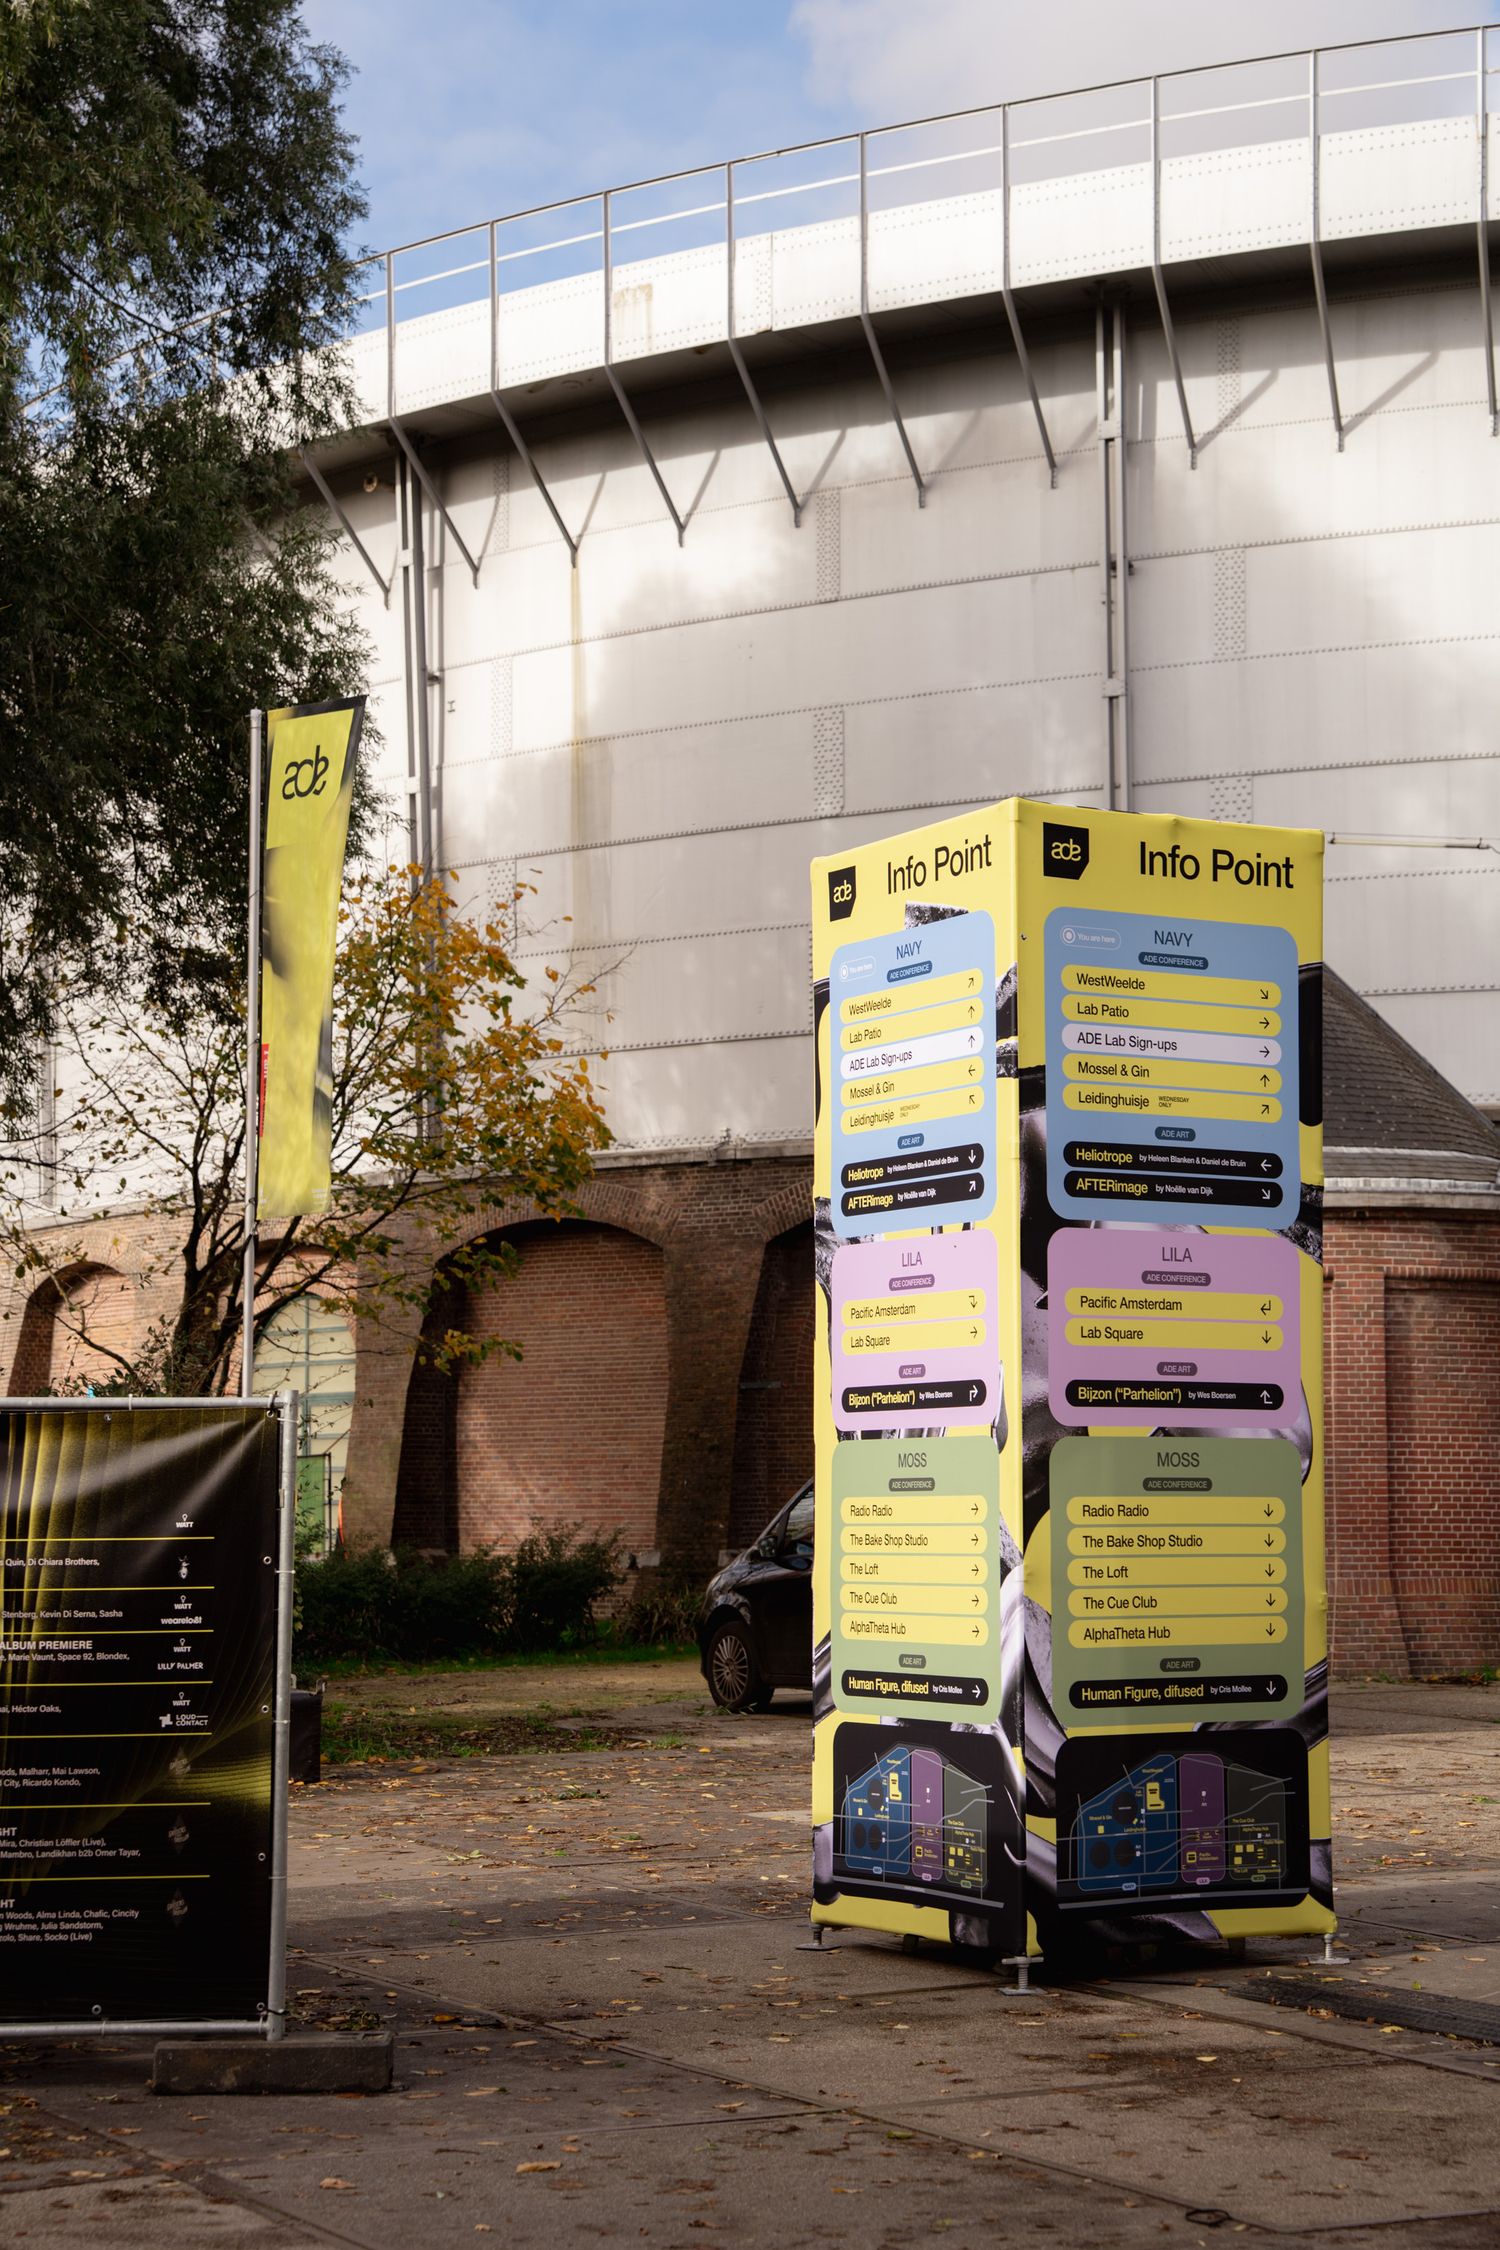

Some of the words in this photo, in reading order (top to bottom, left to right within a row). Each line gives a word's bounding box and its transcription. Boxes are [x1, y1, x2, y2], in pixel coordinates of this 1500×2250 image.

[282, 745, 329, 800] ade
[1051, 838, 1081, 862] ade
[888, 856, 927, 895] Info
[935, 834, 992, 881] Point
[1140, 841, 1200, 880] Info
[1212, 848, 1294, 889] Point
[833, 880, 852, 903] ade
[1077, 932, 1088, 942] You
[1100, 935, 1116, 944] here
[1154, 930, 1193, 947] NAVY
[896, 940, 922, 960] NAVY
[1144, 955, 1158, 964] ADE
[1158, 956, 1204, 968] CONFERENCE
[1076, 973, 1145, 990] WestWeelde
[849, 998, 892, 1016] WestWeelde
[1077, 1002, 1098, 1016] Lab
[1101, 1004, 1129, 1018] Patio
[850, 1032, 862, 1044] Lab
[864, 1028, 882, 1041] Patio
[1077, 1032, 1102, 1045] ADE
[1105, 1034, 1126, 1047] Lab
[1128, 1036, 1178, 1052] Sign-ups
[850, 1060, 865, 1071] ADE
[866, 1056, 879, 1068] Lab
[881, 1050, 912, 1066] Sign-ups
[1078, 1062, 1117, 1076] Mossel
[1121, 1064, 1129, 1077] &
[1131, 1065, 1150, 1078] Gin
[850, 1085, 874, 1100] Mossel
[876, 1083, 882, 1094] &
[883, 1081, 894, 1093] Gin
[1078, 1091, 1150, 1110] Leidinghuisje
[850, 1110, 894, 1128] Leidinghuisje
[1161, 1130, 1176, 1138] ADE
[1176, 1130, 1190, 1139] ART
[1076, 1148, 1133, 1166] Heliotrope
[1139, 1153, 1147, 1162] by
[1148, 1154, 1169, 1163] Heleen
[1170, 1155, 1195, 1164] Blanken
[1195, 1157, 1200, 1165] &
[1201, 1156, 1221, 1166] Daniel
[1221, 1158, 1229, 1166] de
[1230, 1158, 1246, 1167] Bruin
[848, 1167, 884, 1182] Heliotrope
[1076, 1178, 1148, 1196] AFTERimage
[1156, 1184, 1164, 1193] by
[1165, 1184, 1186, 1194] Noëlle
[1200, 1186, 1214, 1196] Dijk
[848, 1194, 894, 1210] AFTERimage
[902, 1251, 922, 1267] LILA
[1162, 1247, 1192, 1262] LILA
[1146, 1274, 1161, 1282] ADE
[1162, 1274, 1206, 1284] CONFERENCE
[850, 1306, 874, 1319] Pacific
[875, 1303, 916, 1317] Amsterdam
[1080, 1296, 1117, 1309] Pacific
[1120, 1297, 1182, 1310] Amsterdam
[850, 1336, 864, 1348] Lab
[865, 1334, 890, 1349] Square
[1080, 1326, 1102, 1339] Lab
[1104, 1327, 1144, 1342] Square
[1178, 1365, 1191, 1373] ART
[849, 1392, 870, 1408] Bijzon
[1078, 1386, 1112, 1403] Bijzon
[1188, 1392, 1196, 1400] by
[1211, 1392, 1236, 1400] Boersen
[898, 1452, 927, 1468] MOSS
[1157, 1452, 1200, 1468] MOSS
[1162, 1481, 1208, 1489] CONFERENCE
[850, 1504, 870, 1516] Radio
[872, 1504, 892, 1516] Radio
[1082, 1504, 1114, 1517] Radio
[1118, 1504, 1149, 1517] Radio
[850, 1534, 863, 1546] The
[865, 1534, 882, 1546] Bake
[884, 1534, 902, 1548] Shop
[904, 1534, 928, 1546] Studio
[1082, 1536, 1104, 1548] The
[1106, 1535, 1134, 1548] Bake
[1137, 1535, 1166, 1550] Shop
[1168, 1534, 1202, 1547] Studio
[5, 1558, 26, 1567] Quin,
[28, 1558, 36, 1566] Di
[38, 1558, 63, 1566] Chiara
[64, 1558, 100, 1566] Brothers,
[850, 1562, 863, 1574] The
[865, 1562, 878, 1575] Loft
[1083, 1566, 1104, 1579] The
[1107, 1566, 1128, 1578] Loft
[850, 1592, 862, 1604] The
[864, 1592, 879, 1604] Cue
[881, 1592, 898, 1604] Club
[1083, 1597, 1104, 1609] The
[1107, 1596, 1130, 1609] Cue
[1132, 1596, 1157, 1608] Club
[2, 1610, 38, 1620] Stenberg,
[40, 1610, 61, 1618] Kevin
[63, 1610, 72, 1618] Di
[73, 1610, 98, 1618] Serna,
[99, 1610, 123, 1618] Sasha
[850, 1620, 890, 1635] AlphaTheta
[891, 1622, 906, 1634] Hub
[1084, 1627, 1145, 1643] AlphaTheta
[1148, 1626, 1170, 1638] Hub
[0, 1640, 36, 1650] ALBUM
[39, 1640, 93, 1650] PREMIERE
[32, 1653, 56, 1661] Vaunt,
[58, 1652, 81, 1662] Space
[83, 1652, 95, 1661] 92,
[96, 1652, 130, 1660] Blondex,
[158, 1662, 176, 1670] LILLY
[176, 1662, 204, 1670] PALMER
[848, 1677, 874, 1690] Human
[876, 1679, 900, 1694] Figure,
[902, 1680, 928, 1694] difused
[1082, 1688, 1122, 1701] Human
[1124, 1686, 1162, 1702] Figure,
[1164, 1685, 1204, 1698] difused
[1210, 1686, 1218, 1694] by
[1218, 1686, 1231, 1694] Cris
[1232, 1685, 1252, 1694] Mollee
[12, 1705, 38, 1713] Héctor
[40, 1704, 62, 1714] Oaks,
[19, 1839, 54, 1848] Christian
[55, 1838, 80, 1846] Löffler
[1, 1850, 34, 1859] Mambro,
[36, 1850, 77, 1858] Landikhan
[78, 1849, 94, 1857] b2b
[94, 1849, 117, 1857] Omer
[118, 1848, 141, 1858] Tayar,
